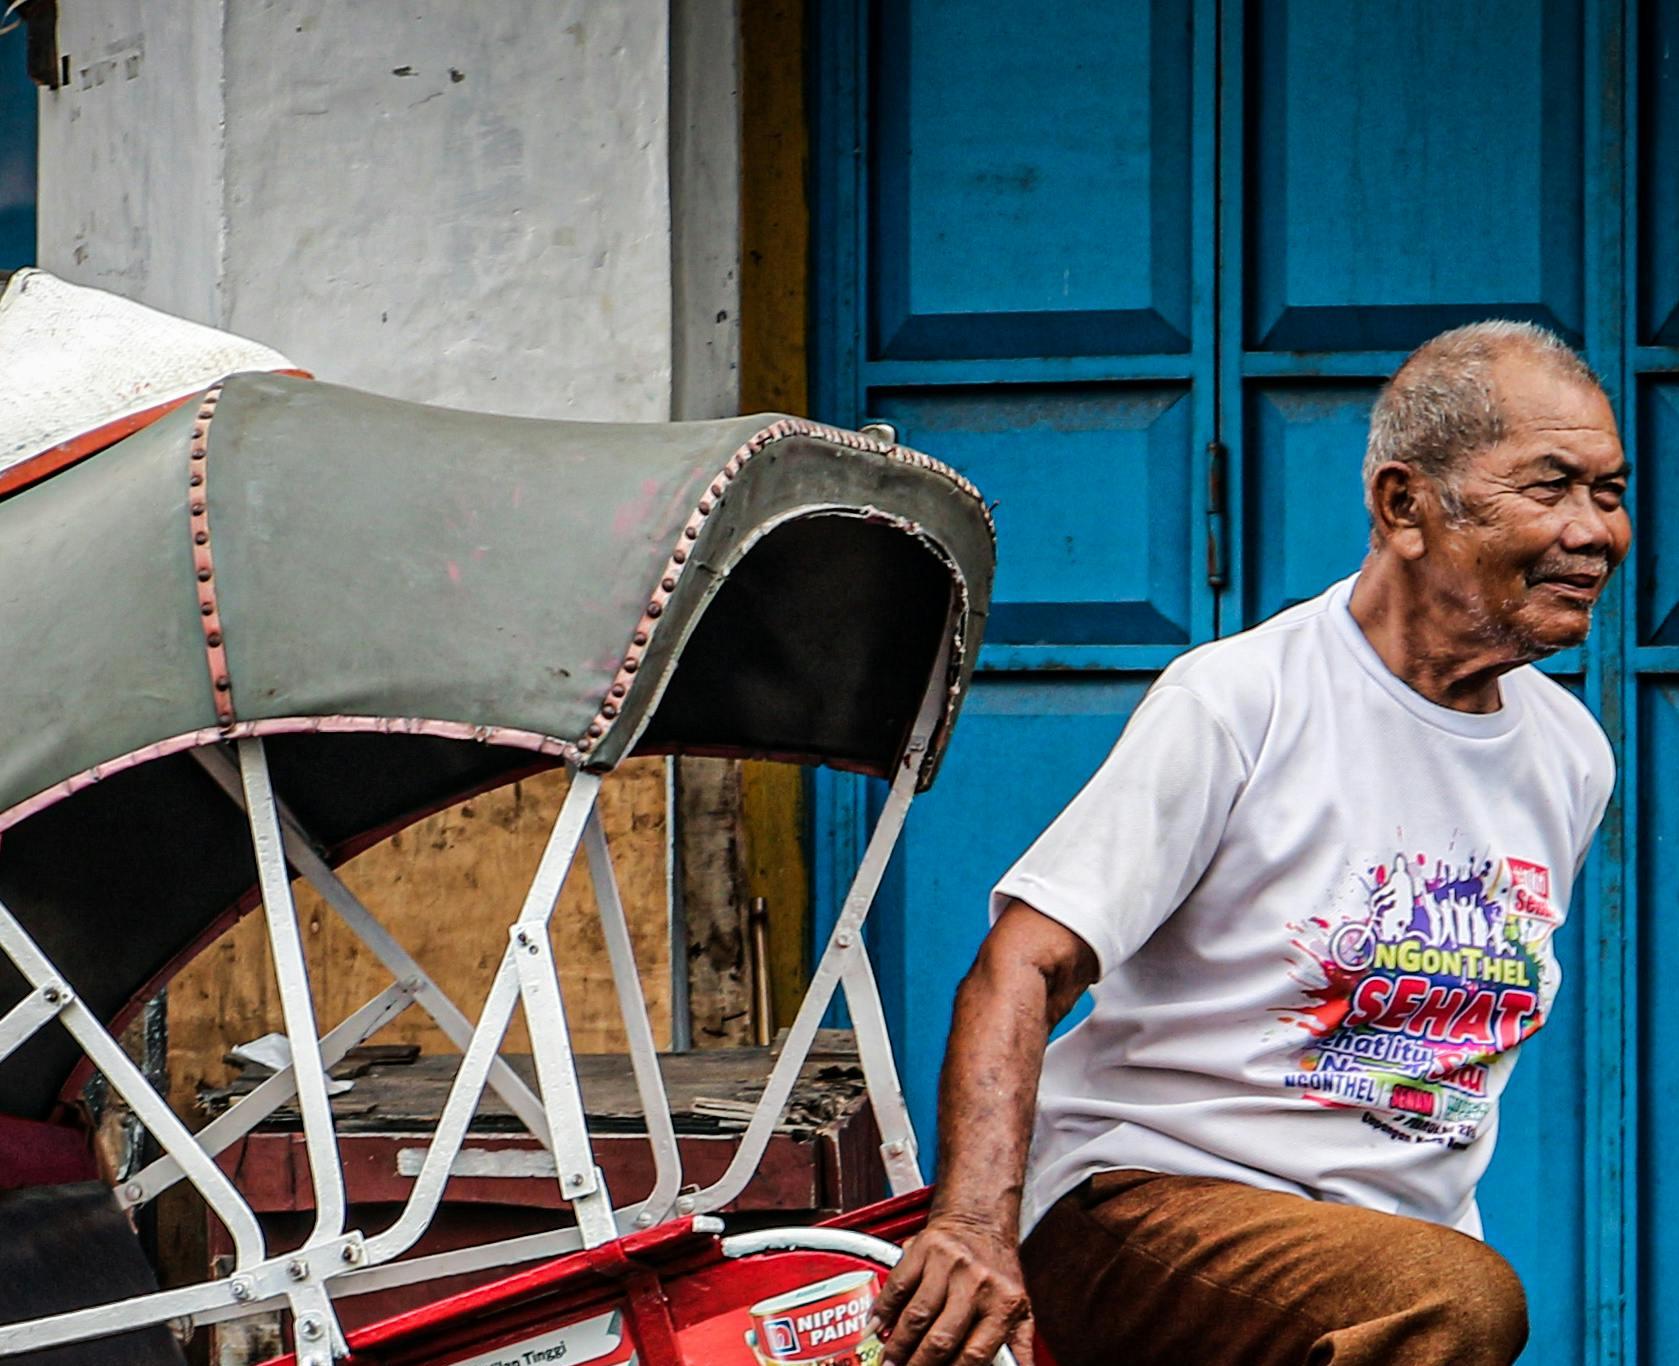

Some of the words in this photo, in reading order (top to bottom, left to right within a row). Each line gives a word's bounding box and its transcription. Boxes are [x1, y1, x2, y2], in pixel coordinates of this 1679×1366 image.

[1346, 976, 1534, 1051] SEHAT
[797, 1294, 872, 1332] NIPPON
[810, 1314, 867, 1346] PAINT
[522, 1341, 568, 1366] Tinggi
